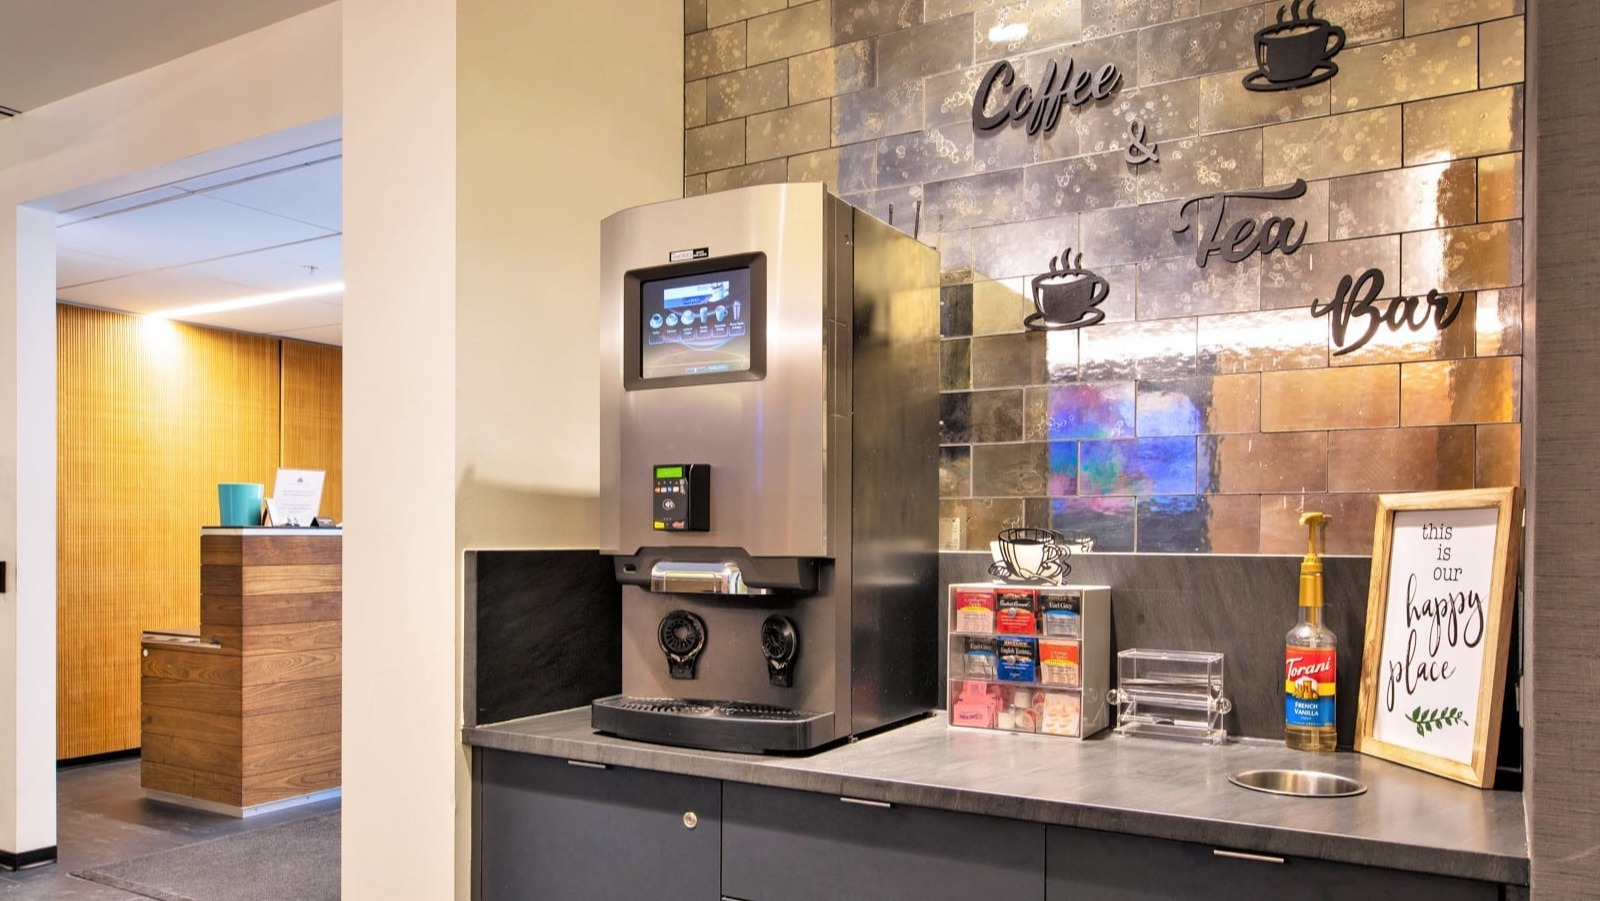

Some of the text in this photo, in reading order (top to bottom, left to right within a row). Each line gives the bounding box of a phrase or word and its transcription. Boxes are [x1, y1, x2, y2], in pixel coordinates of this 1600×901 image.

[971, 56, 1123, 136] Coffee
[1123, 119, 1159, 164] &
[1172, 178, 1307, 268] Tea
[1311, 267, 1464, 355] Bar
[1422, 523, 1453, 540] this
[1436, 544, 1451, 561] is
[1433, 566, 1463, 582] our
[1060, 602, 1072, 610] Grey
[1406, 573, 1488, 657] happy
[1286, 657, 1331, 681] Torani
[1386, 629, 1456, 712] place
[1294, 708, 1319, 716] VANILLA
[1295, 701, 1318, 709] FRENCH
